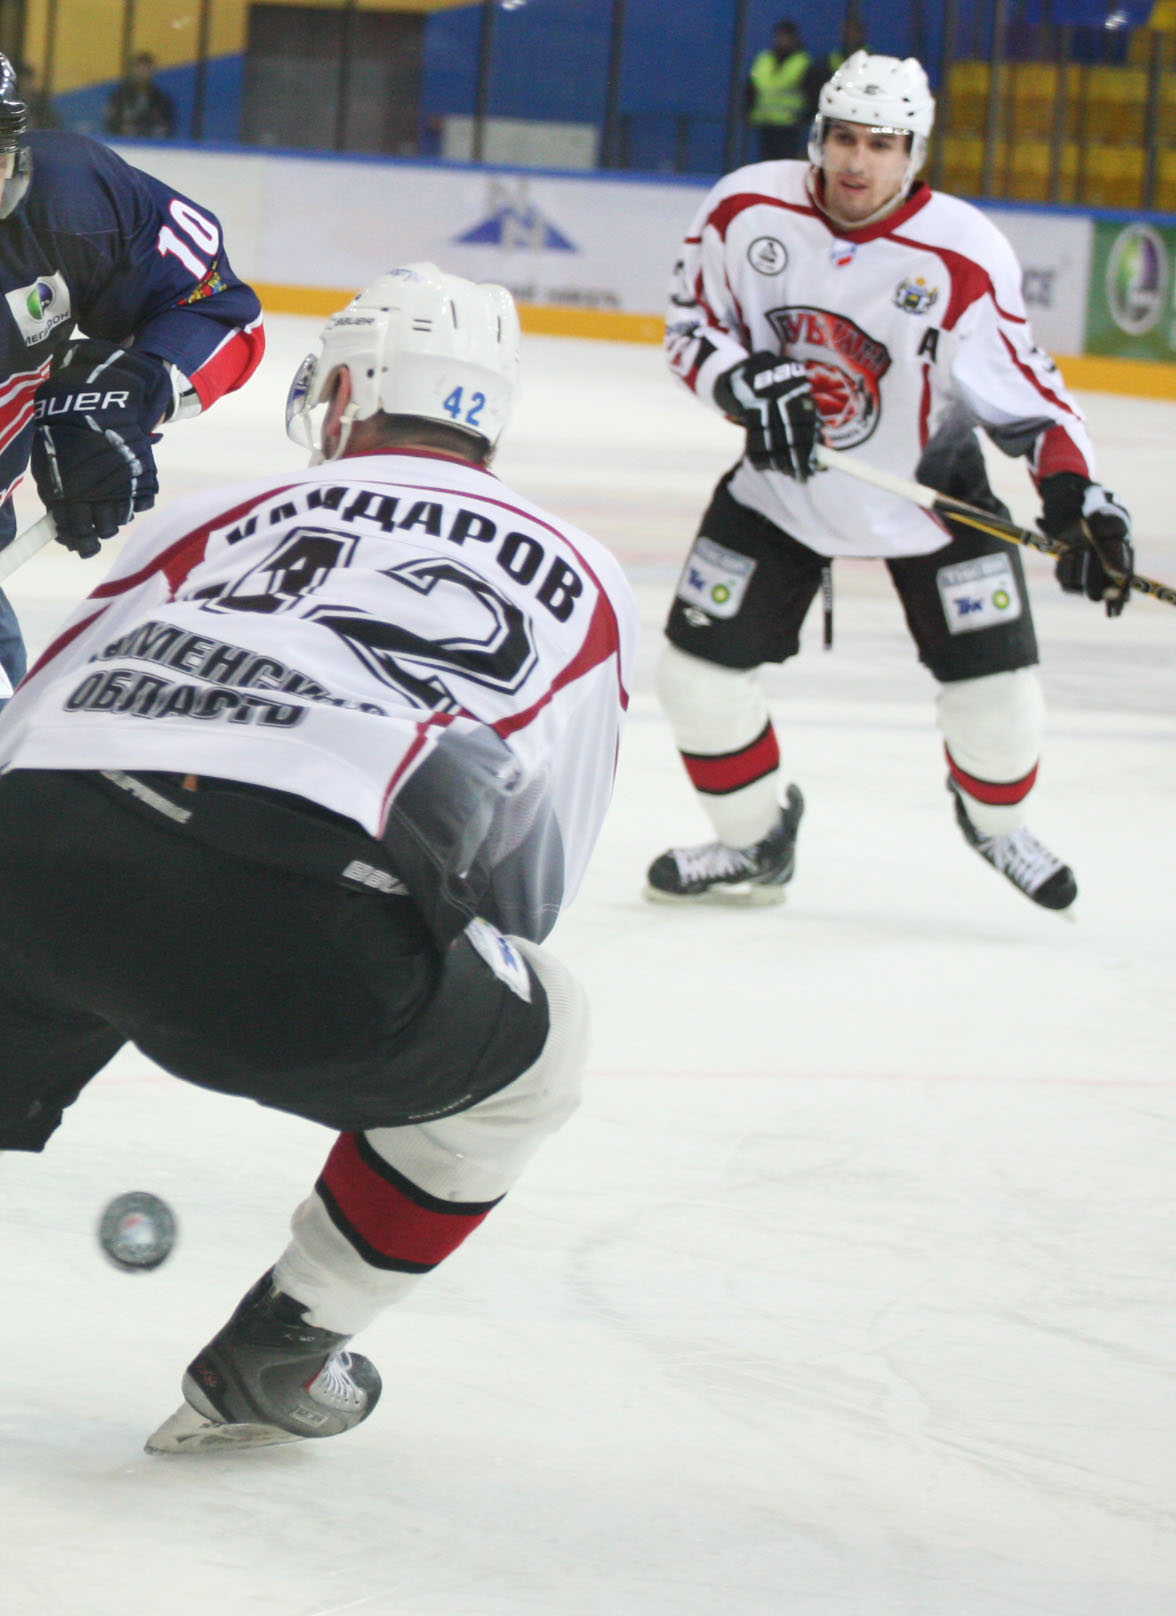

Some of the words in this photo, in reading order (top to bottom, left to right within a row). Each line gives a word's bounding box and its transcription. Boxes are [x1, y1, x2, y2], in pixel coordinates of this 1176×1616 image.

[155, 198, 220, 282] 10
[34, 390, 130, 420] AUER
[442, 386, 486, 427] 42
[183, 526, 539, 716] 42
